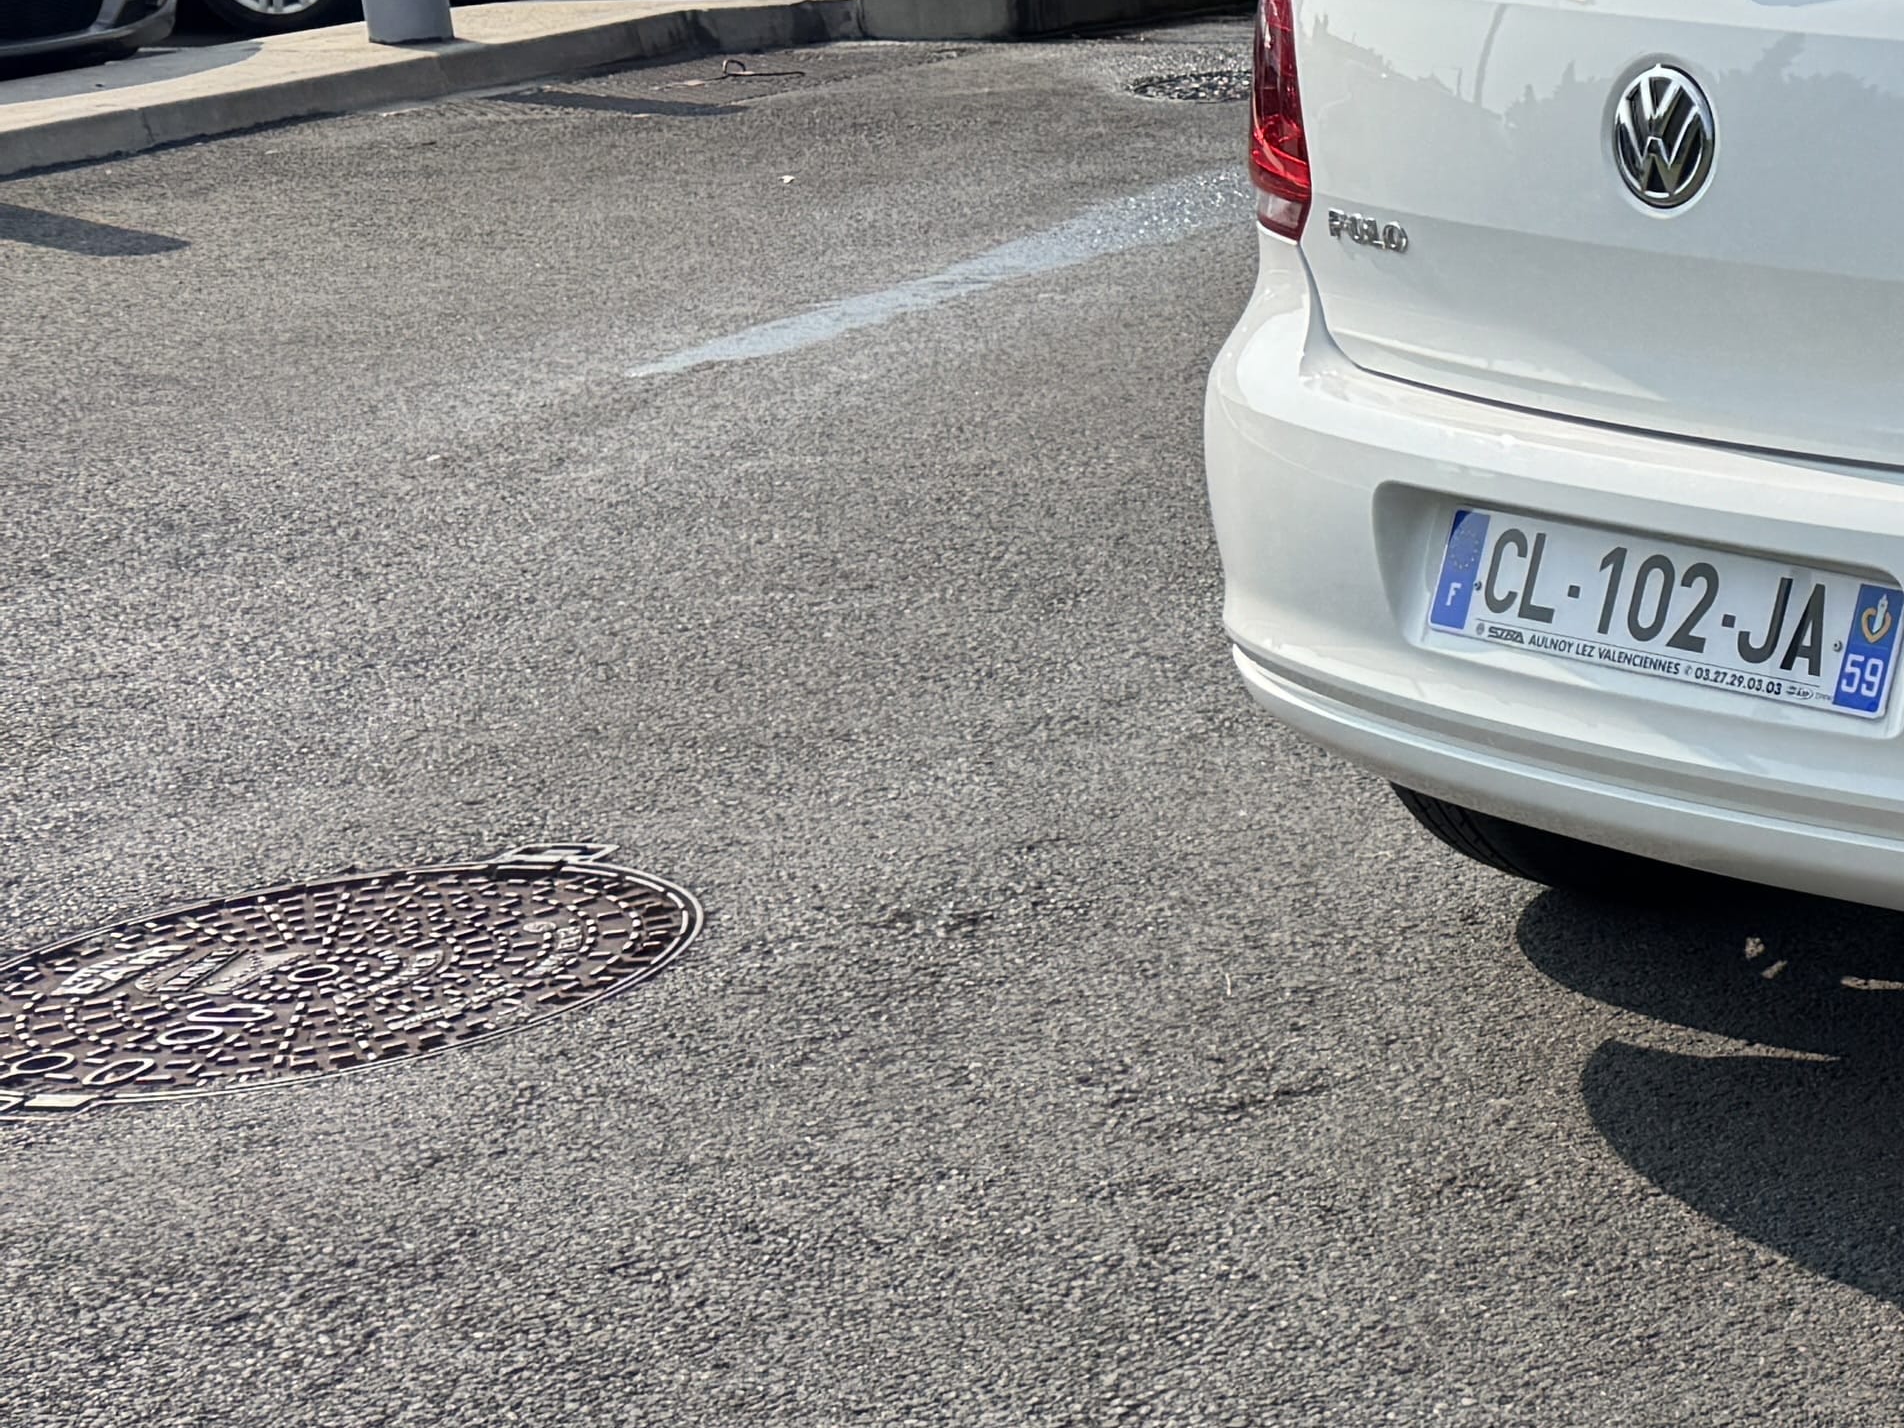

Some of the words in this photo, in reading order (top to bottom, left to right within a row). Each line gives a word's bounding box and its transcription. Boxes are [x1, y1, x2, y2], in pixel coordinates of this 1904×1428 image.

[1327, 207, 1409, 254] POLO
[1445, 581, 1463, 606] F
[1483, 527, 1827, 678] CL-102-JA
[1840, 652, 1885, 699] 59
[1528, 633, 1576, 653] AULNOY
[1575, 642, 1596, 658] LEZ
[1597, 647, 1682, 676] VALENCIENNES
[1693, 666, 1783, 696] 03.27.29.03.03
